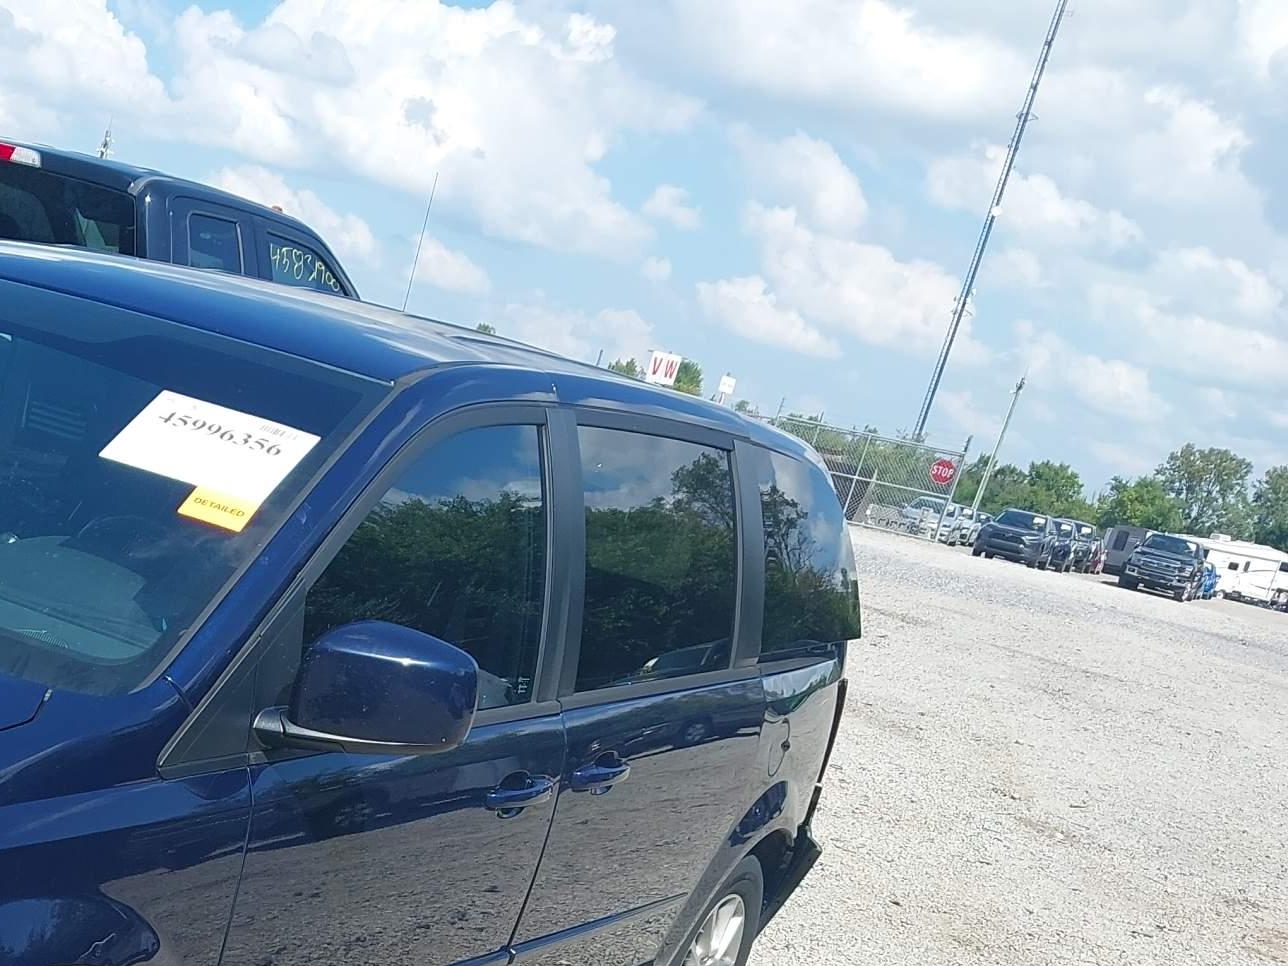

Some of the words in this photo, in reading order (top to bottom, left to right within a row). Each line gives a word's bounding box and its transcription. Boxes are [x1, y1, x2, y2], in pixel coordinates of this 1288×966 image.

[158, 411, 282, 457] 45996356
[931, 465, 955, 478] STOP
[193, 497, 245, 518] DETAILED
